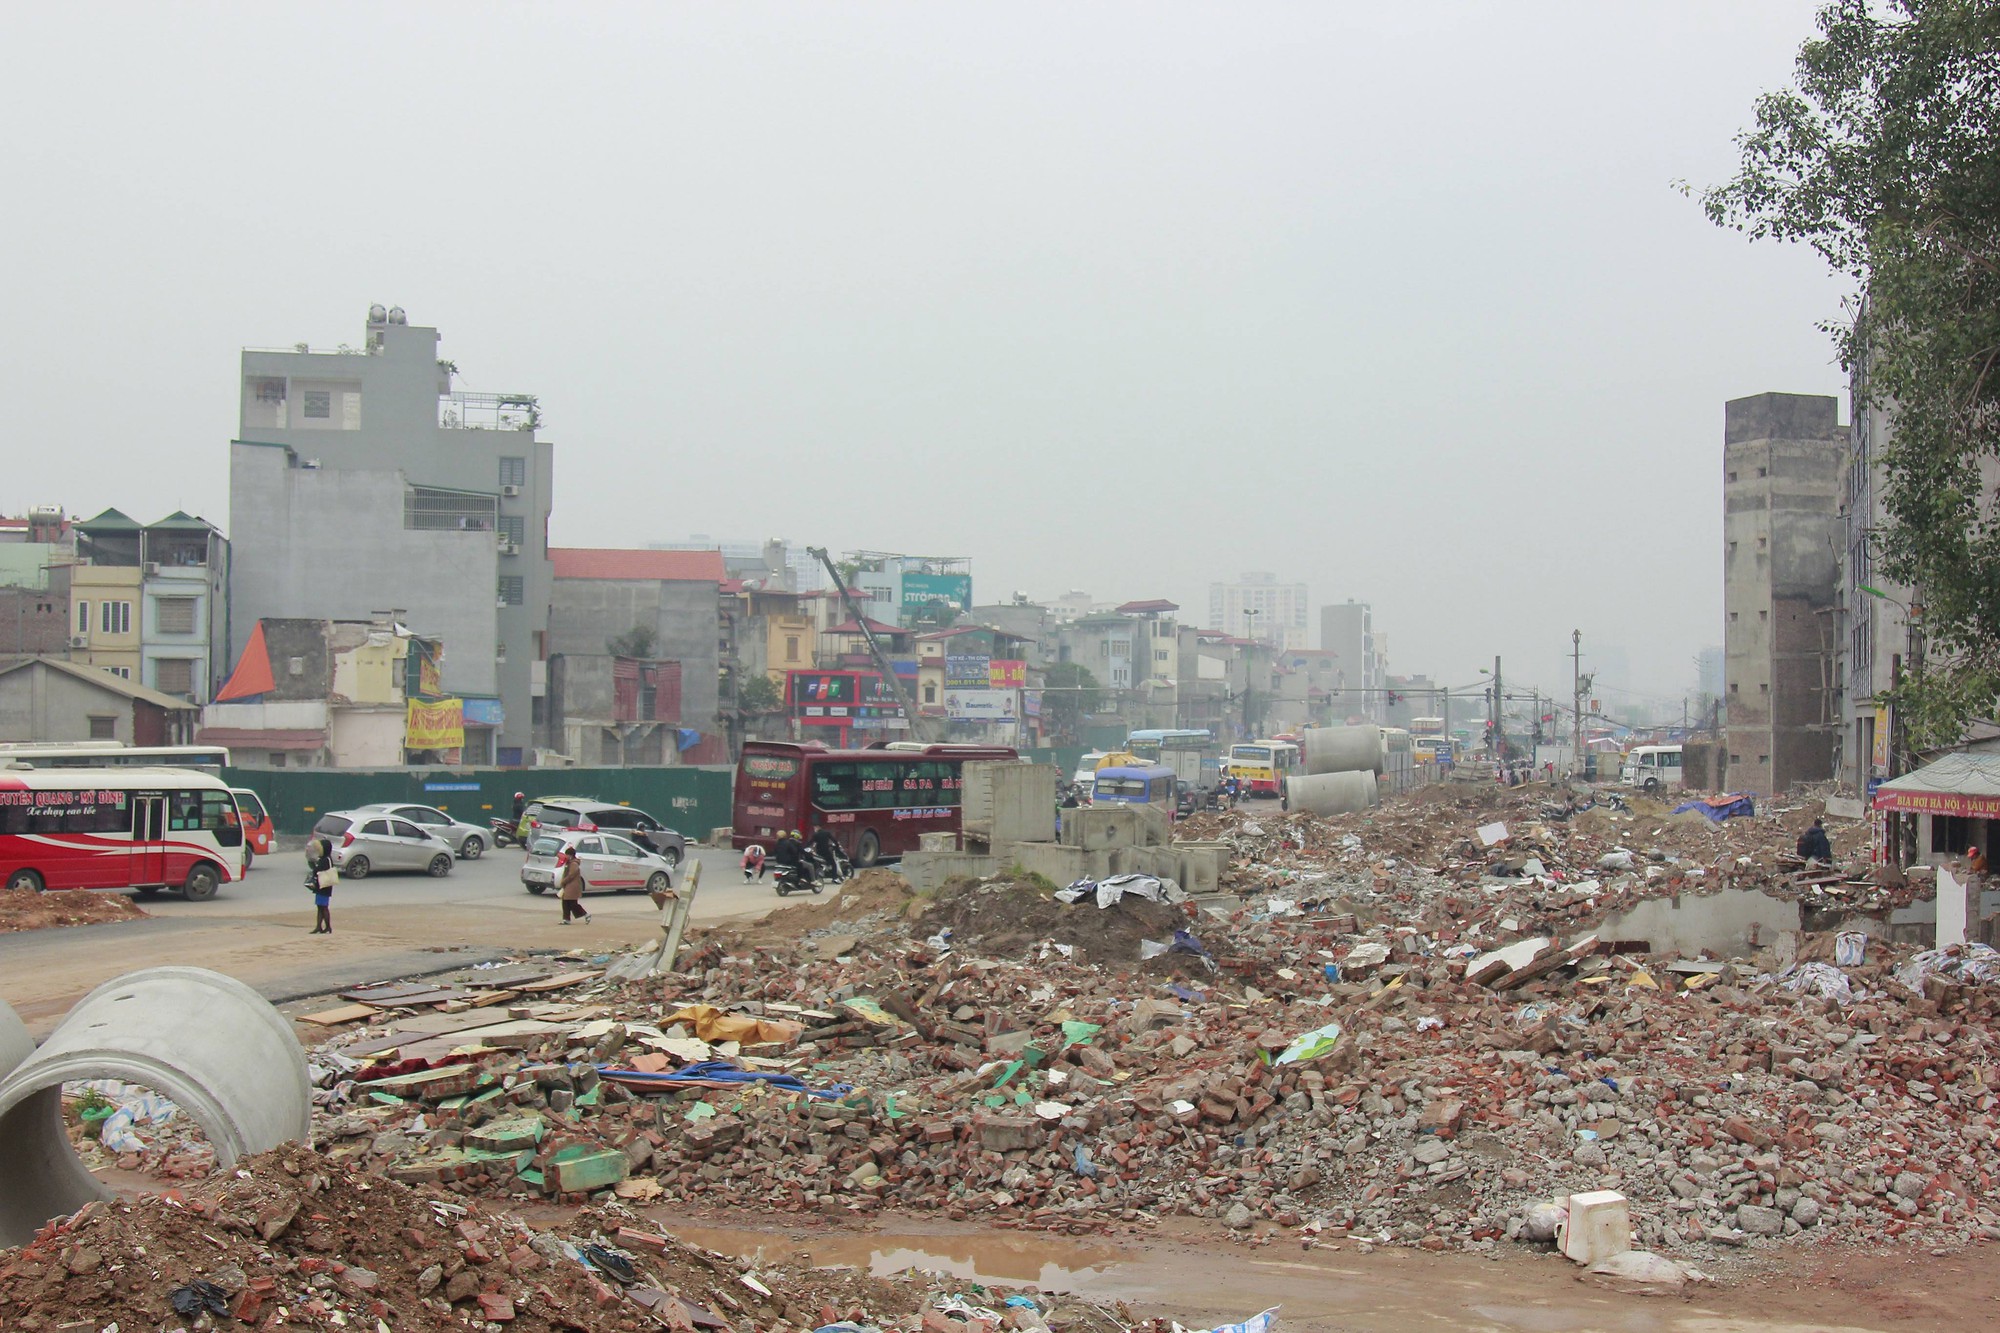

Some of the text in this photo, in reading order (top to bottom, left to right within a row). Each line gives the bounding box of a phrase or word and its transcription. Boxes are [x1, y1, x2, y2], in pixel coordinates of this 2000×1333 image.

[807, 682, 839, 695] FPT
[903, 778, 917, 790] SA
[919, 778, 933, 790] PA
[36, 791, 73, 807] QUANG
[98, 789, 125, 804] ĐÌNH
[1897, 795, 1911, 807] BIA
[1930, 795, 1942, 809] HÀ
[1944, 796, 1960, 812] NỘI
[42, 806, 64, 817] chạy
[66, 808, 82, 816] cao
